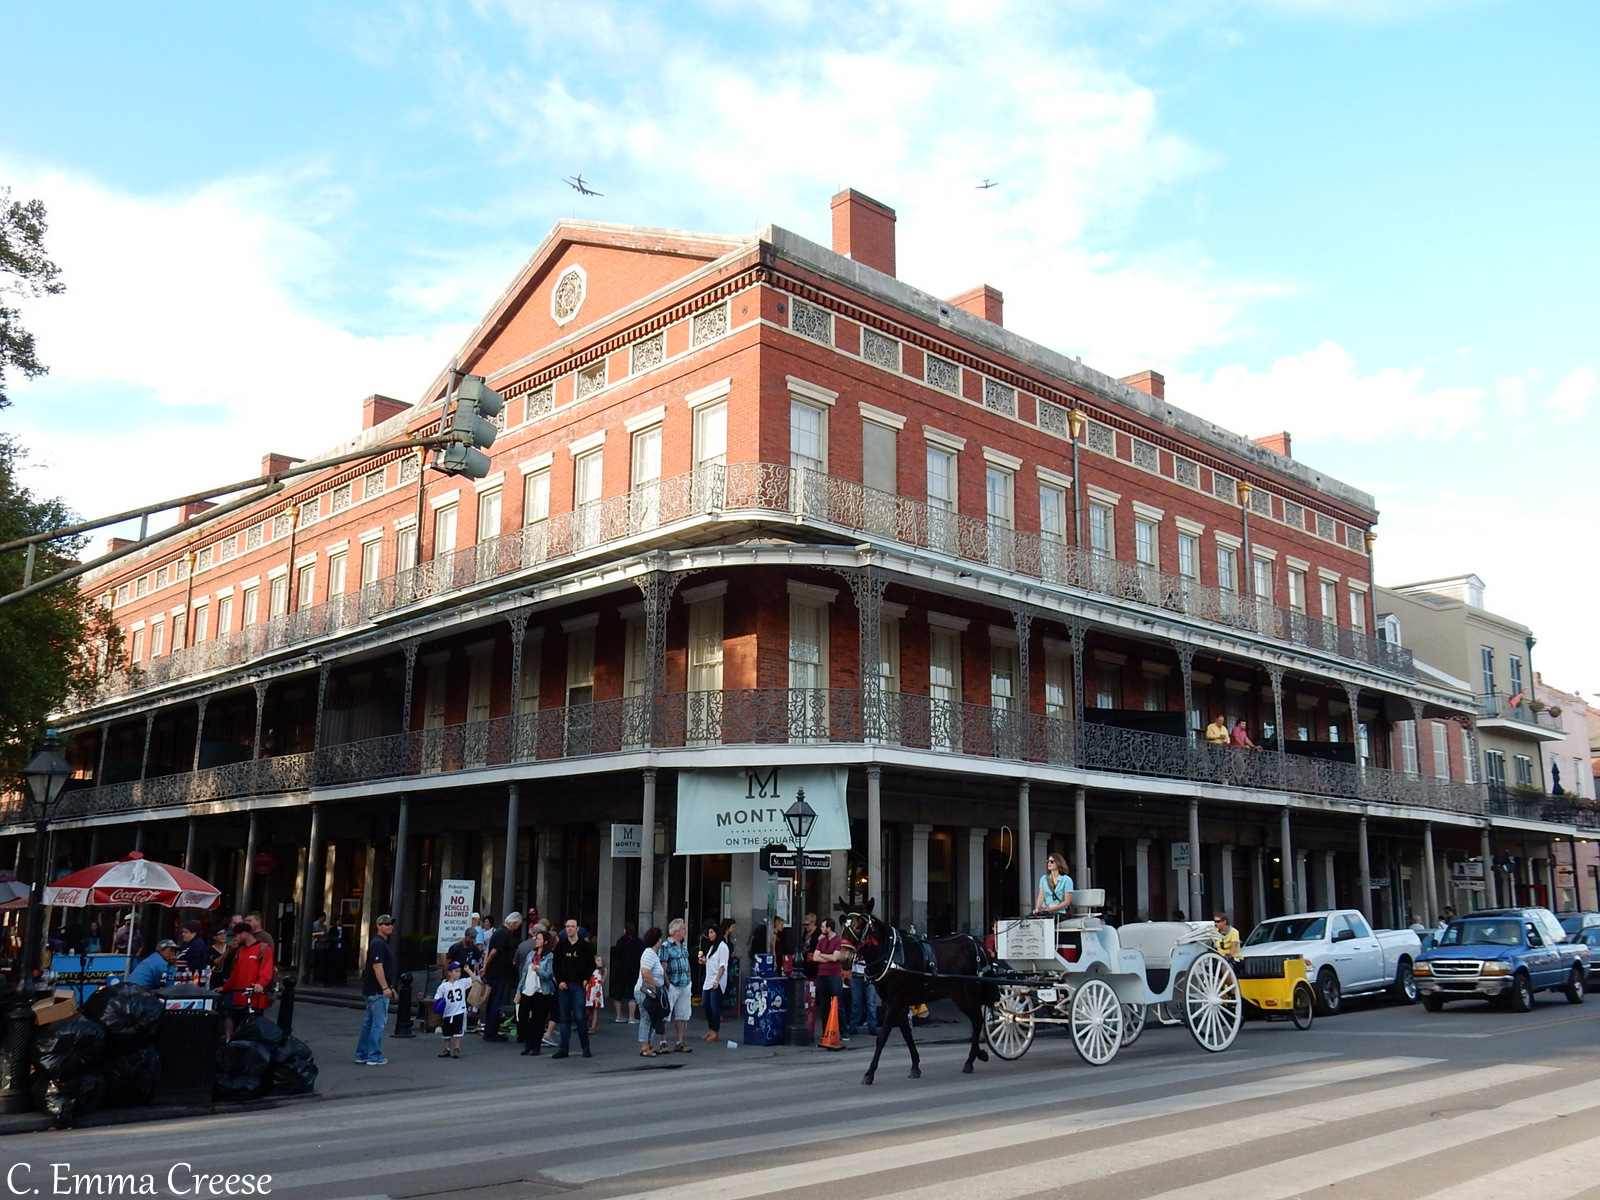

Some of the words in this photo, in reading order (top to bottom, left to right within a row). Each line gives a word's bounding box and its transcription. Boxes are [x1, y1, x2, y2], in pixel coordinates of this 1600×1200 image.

[623, 827, 633, 839] M
[725, 838, 740, 846] ON
[743, 837, 760, 845] THE
[762, 836, 801, 845] SQUARE
[772, 857, 781, 865] St.
[782, 857, 794, 866] Ann
[804, 858, 829, 867] Decatur
[450, 896, 465, 905] NO
[447, 988, 463, 1003] 43
